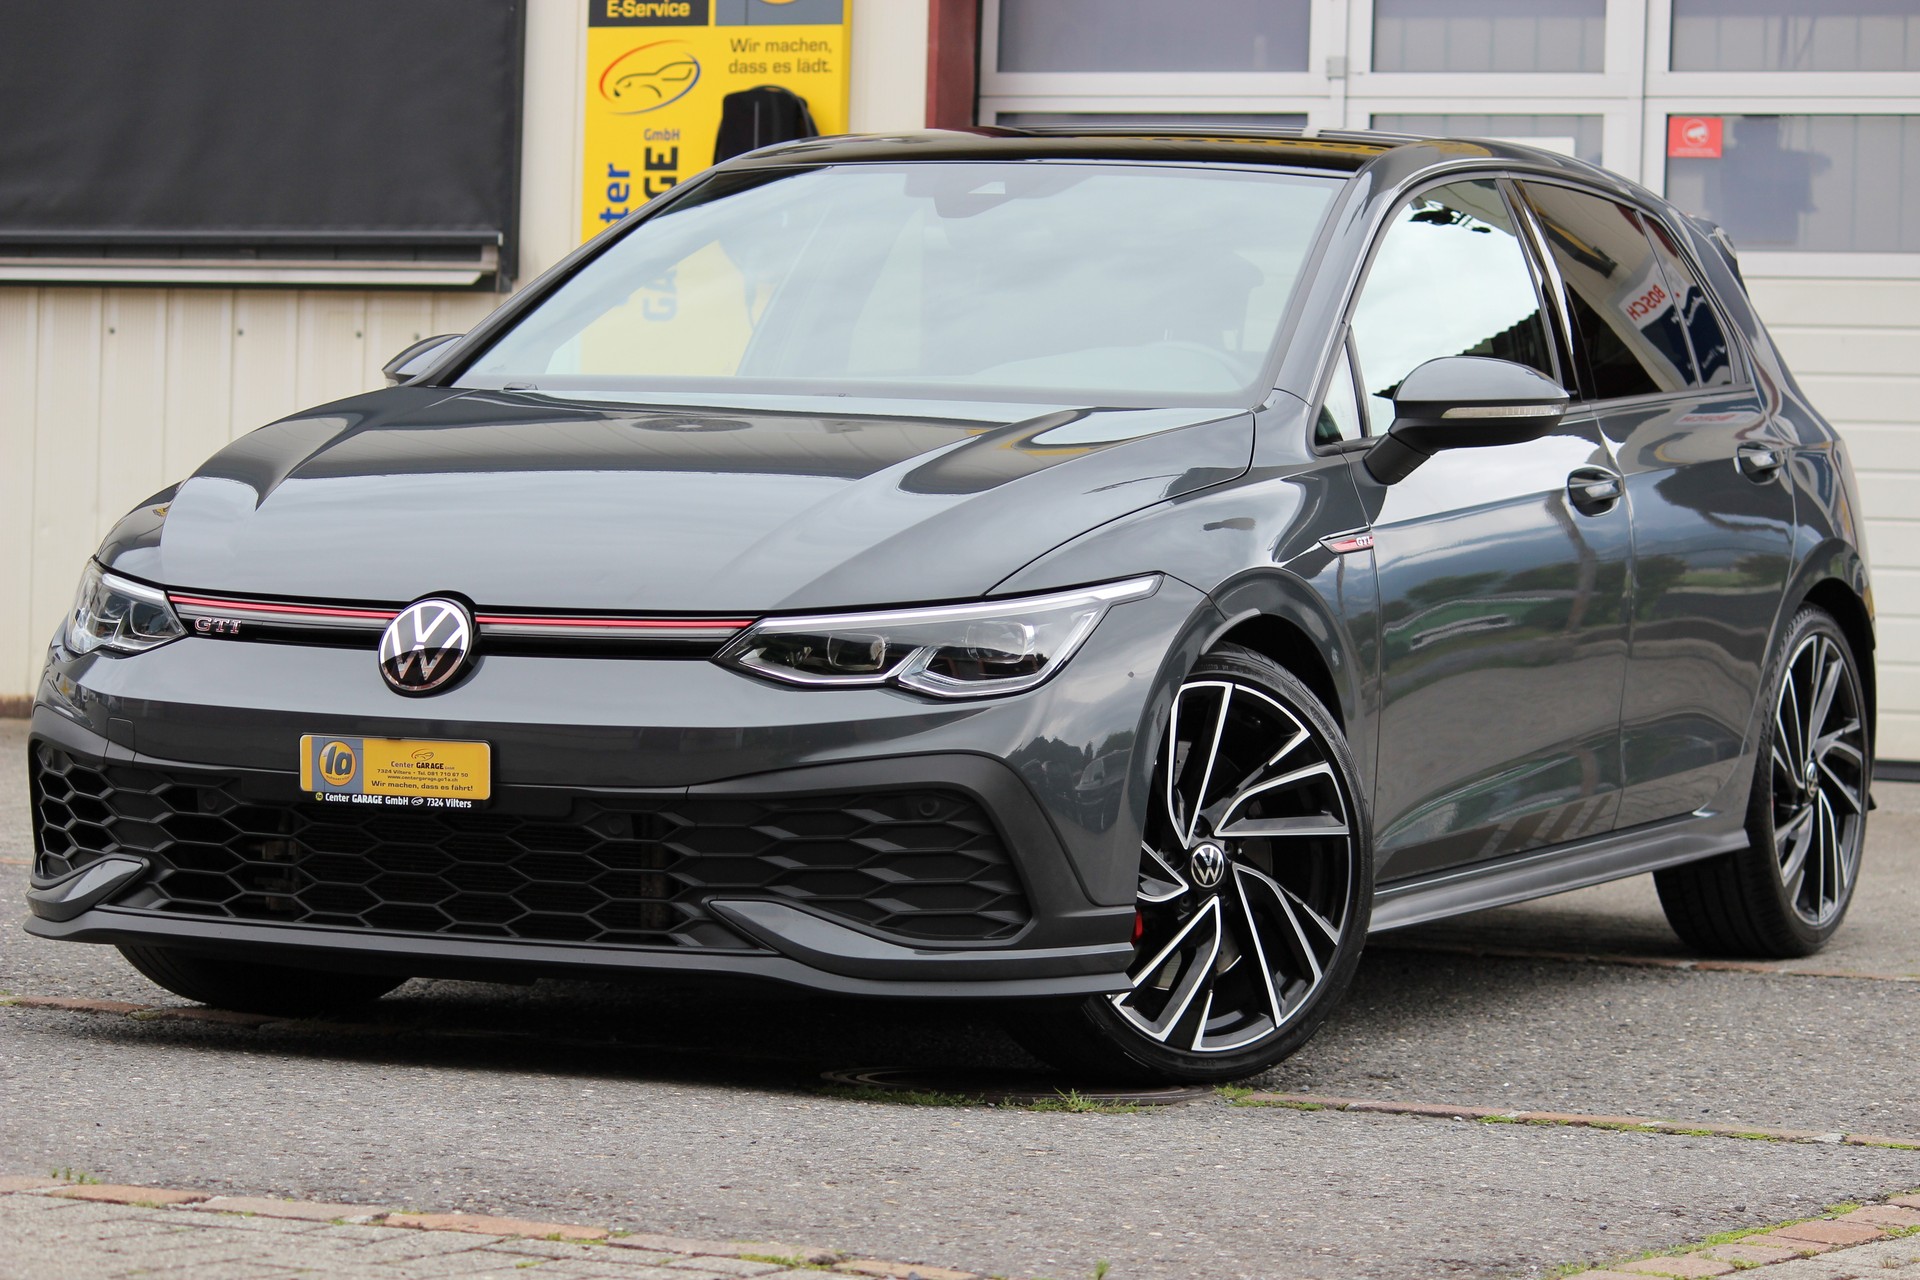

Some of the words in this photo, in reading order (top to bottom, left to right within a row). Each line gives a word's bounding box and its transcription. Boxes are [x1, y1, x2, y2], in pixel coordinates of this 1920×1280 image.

[607, 0, 690, 18] E-Service
[730, 38, 761, 53] Wir
[765, 38, 832, 54] machen,
[729, 60, 767, 74] dass
[772, 63, 791, 74] es
[643, 128, 680, 141] GmbH
[1355, 536, 1371, 547] GTI
[194, 616, 242, 635] GTI
[391, 761, 414, 769] Center
[416, 762, 444, 770] GARAGE
[388, 782, 420, 790] machen,
[325, 793, 350, 802] Center
[352, 795, 383, 804] GARAGE
[385, 796, 409, 806] GmbH
[427, 797, 444, 807] 7324
[446, 798, 472, 809] Vilters
